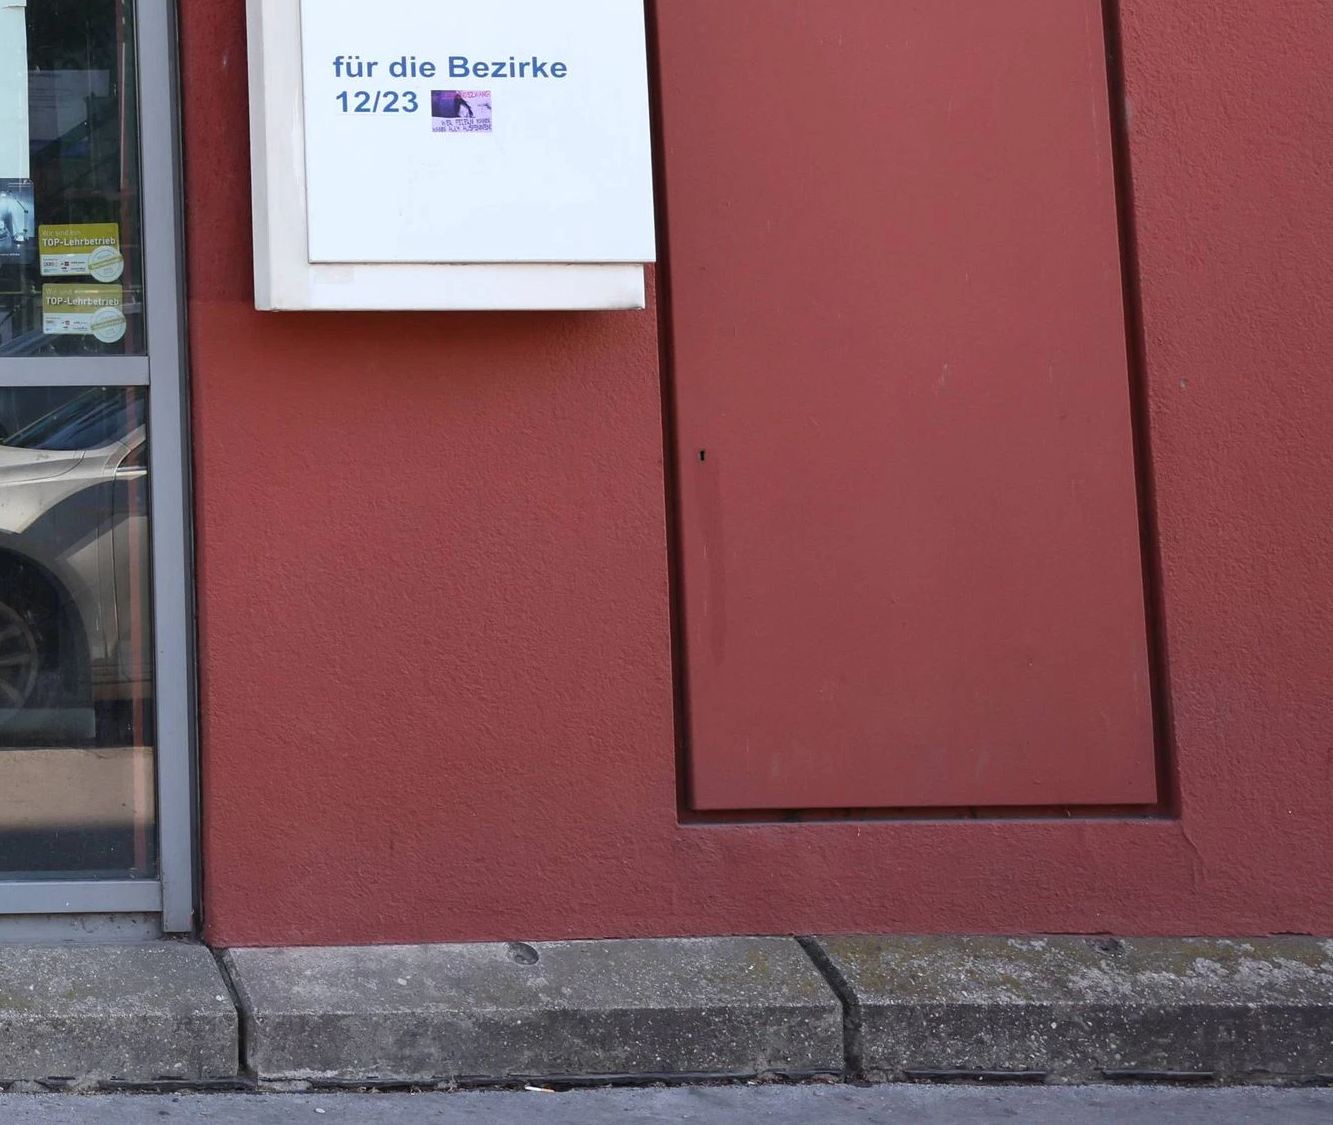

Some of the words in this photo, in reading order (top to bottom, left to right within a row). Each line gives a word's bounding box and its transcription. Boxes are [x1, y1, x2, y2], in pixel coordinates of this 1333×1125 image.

[333, 55, 378, 78] für
[389, 55, 436, 78] die
[448, 55, 568, 79] Bezirke
[336, 90, 419, 114] 12/23
[42, 237, 117, 247] TOP-Lehrbetrieb
[46, 296, 120, 306] TOP-Lehrbetrieb
